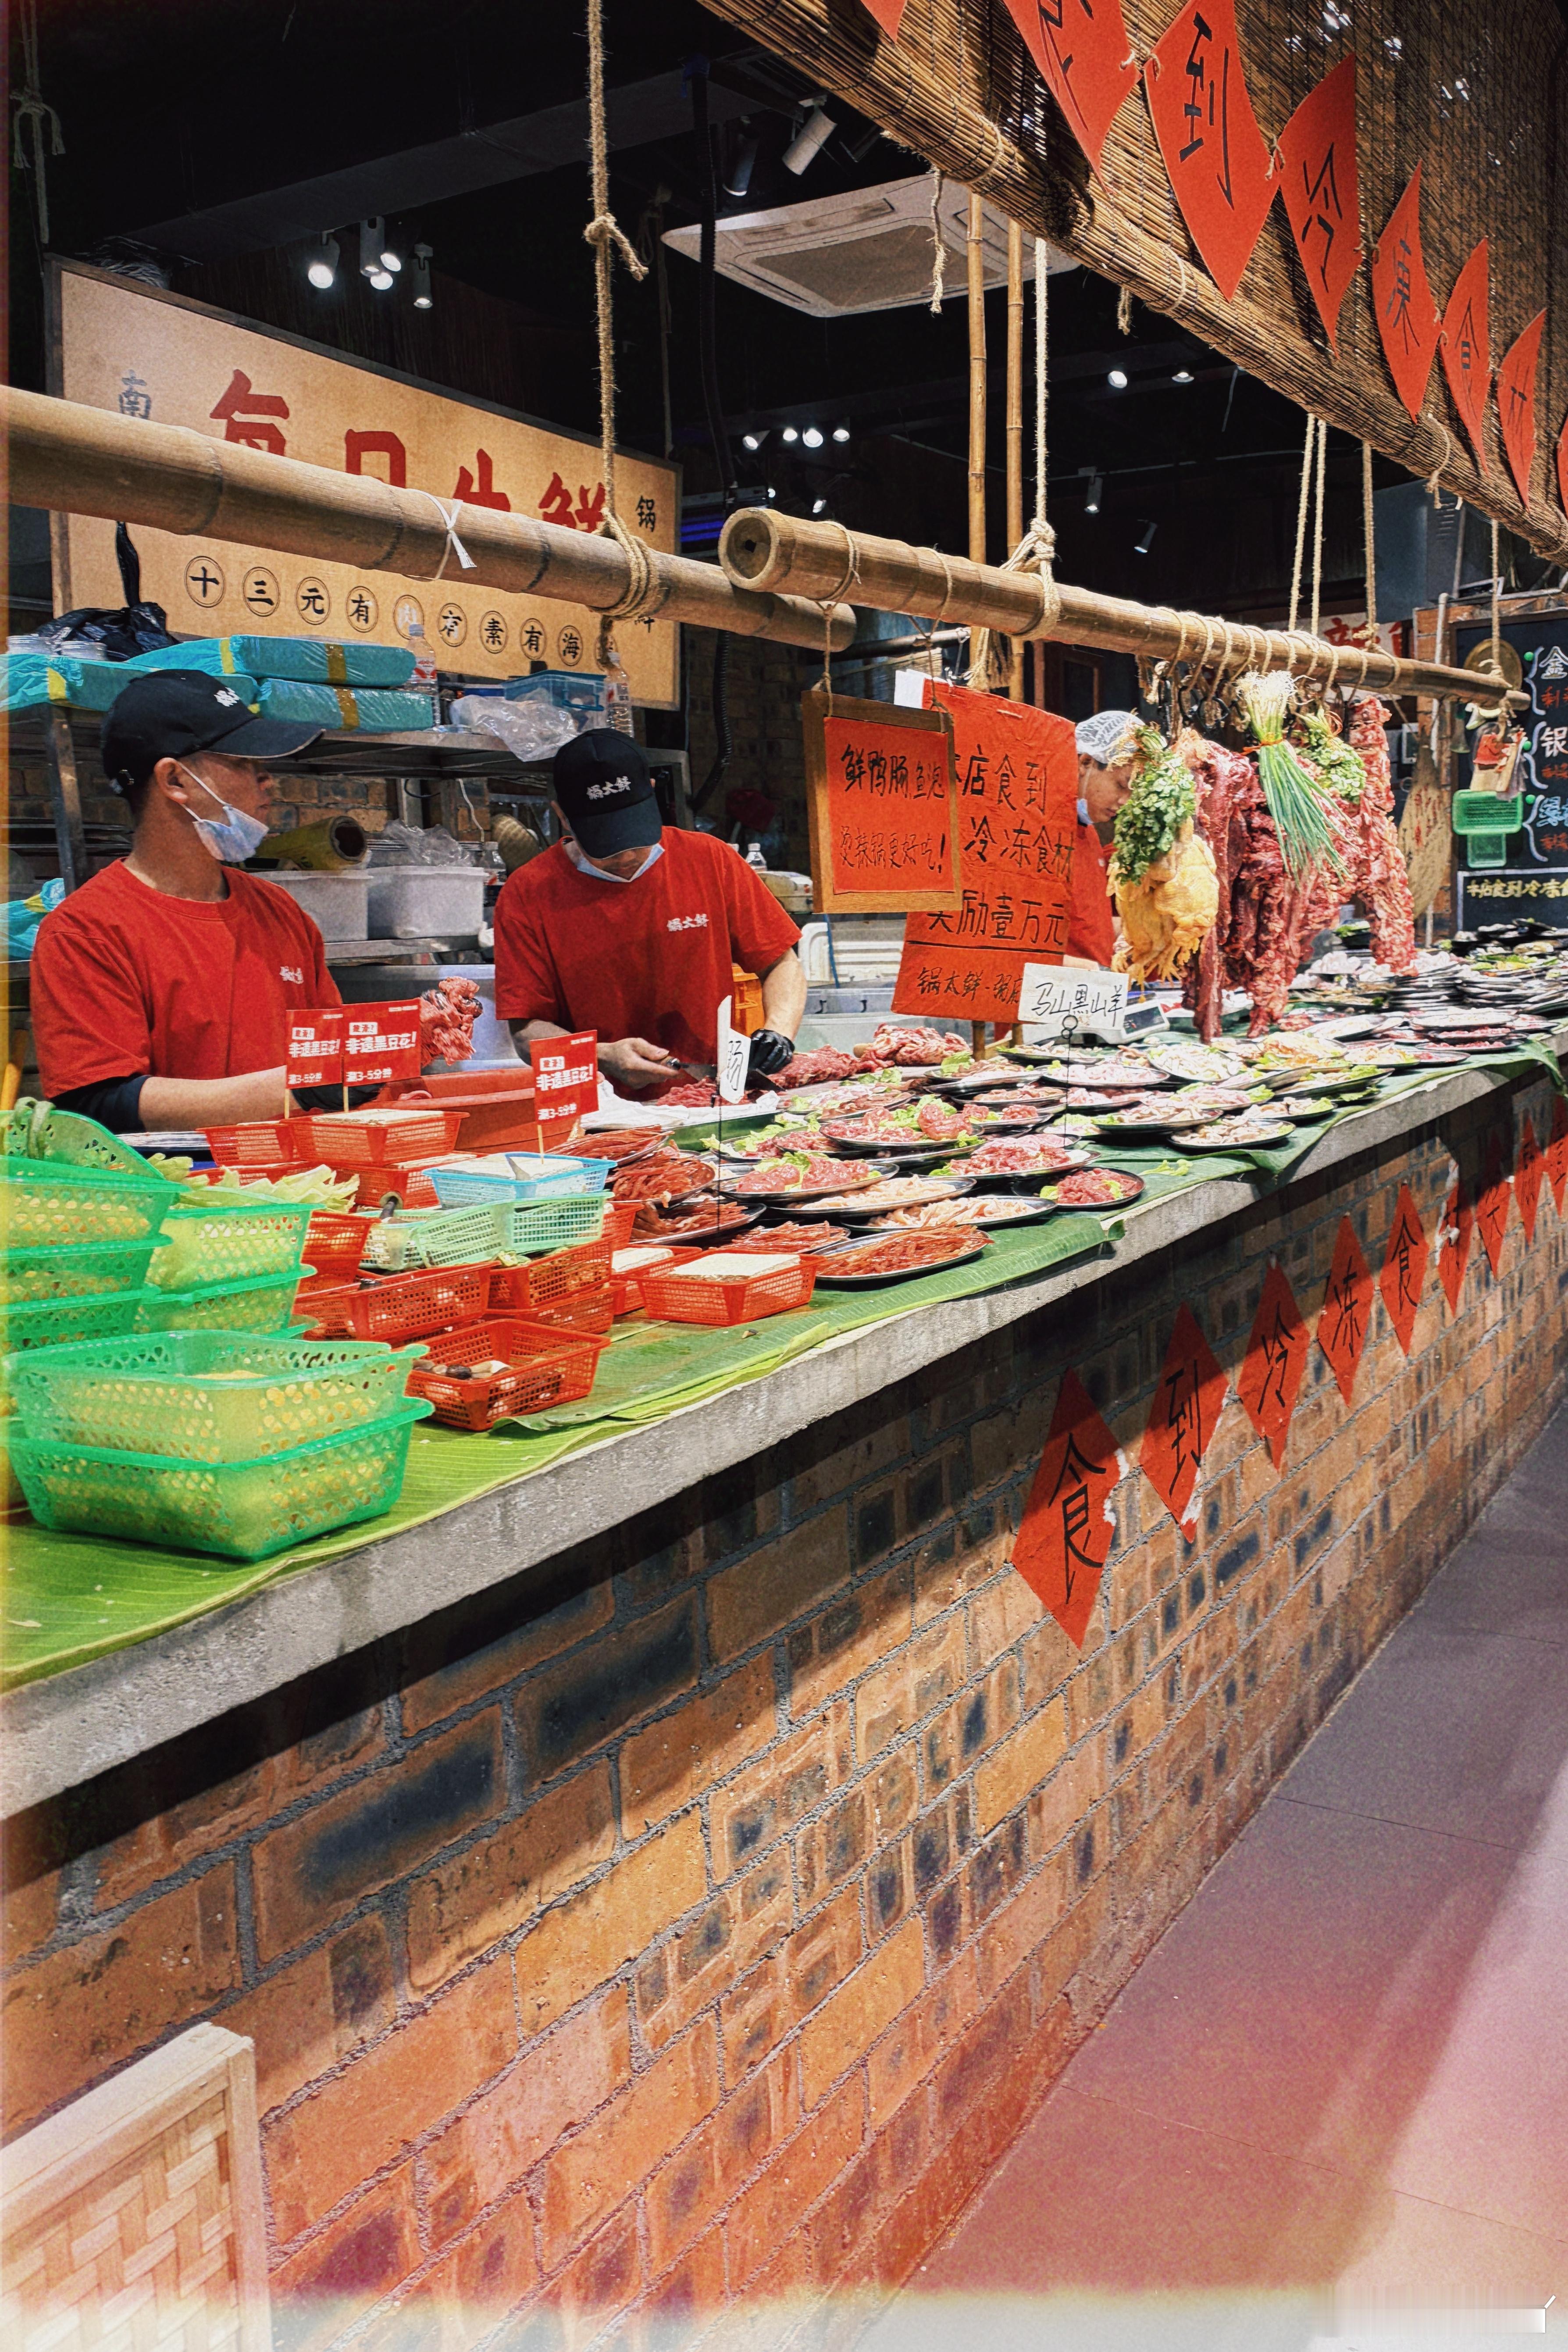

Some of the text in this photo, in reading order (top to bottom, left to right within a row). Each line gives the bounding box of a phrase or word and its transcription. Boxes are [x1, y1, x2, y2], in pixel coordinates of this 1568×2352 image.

[1031, 981, 1127, 1028] 马山黑山羊
[1048, 1431, 1107, 1605] 食
